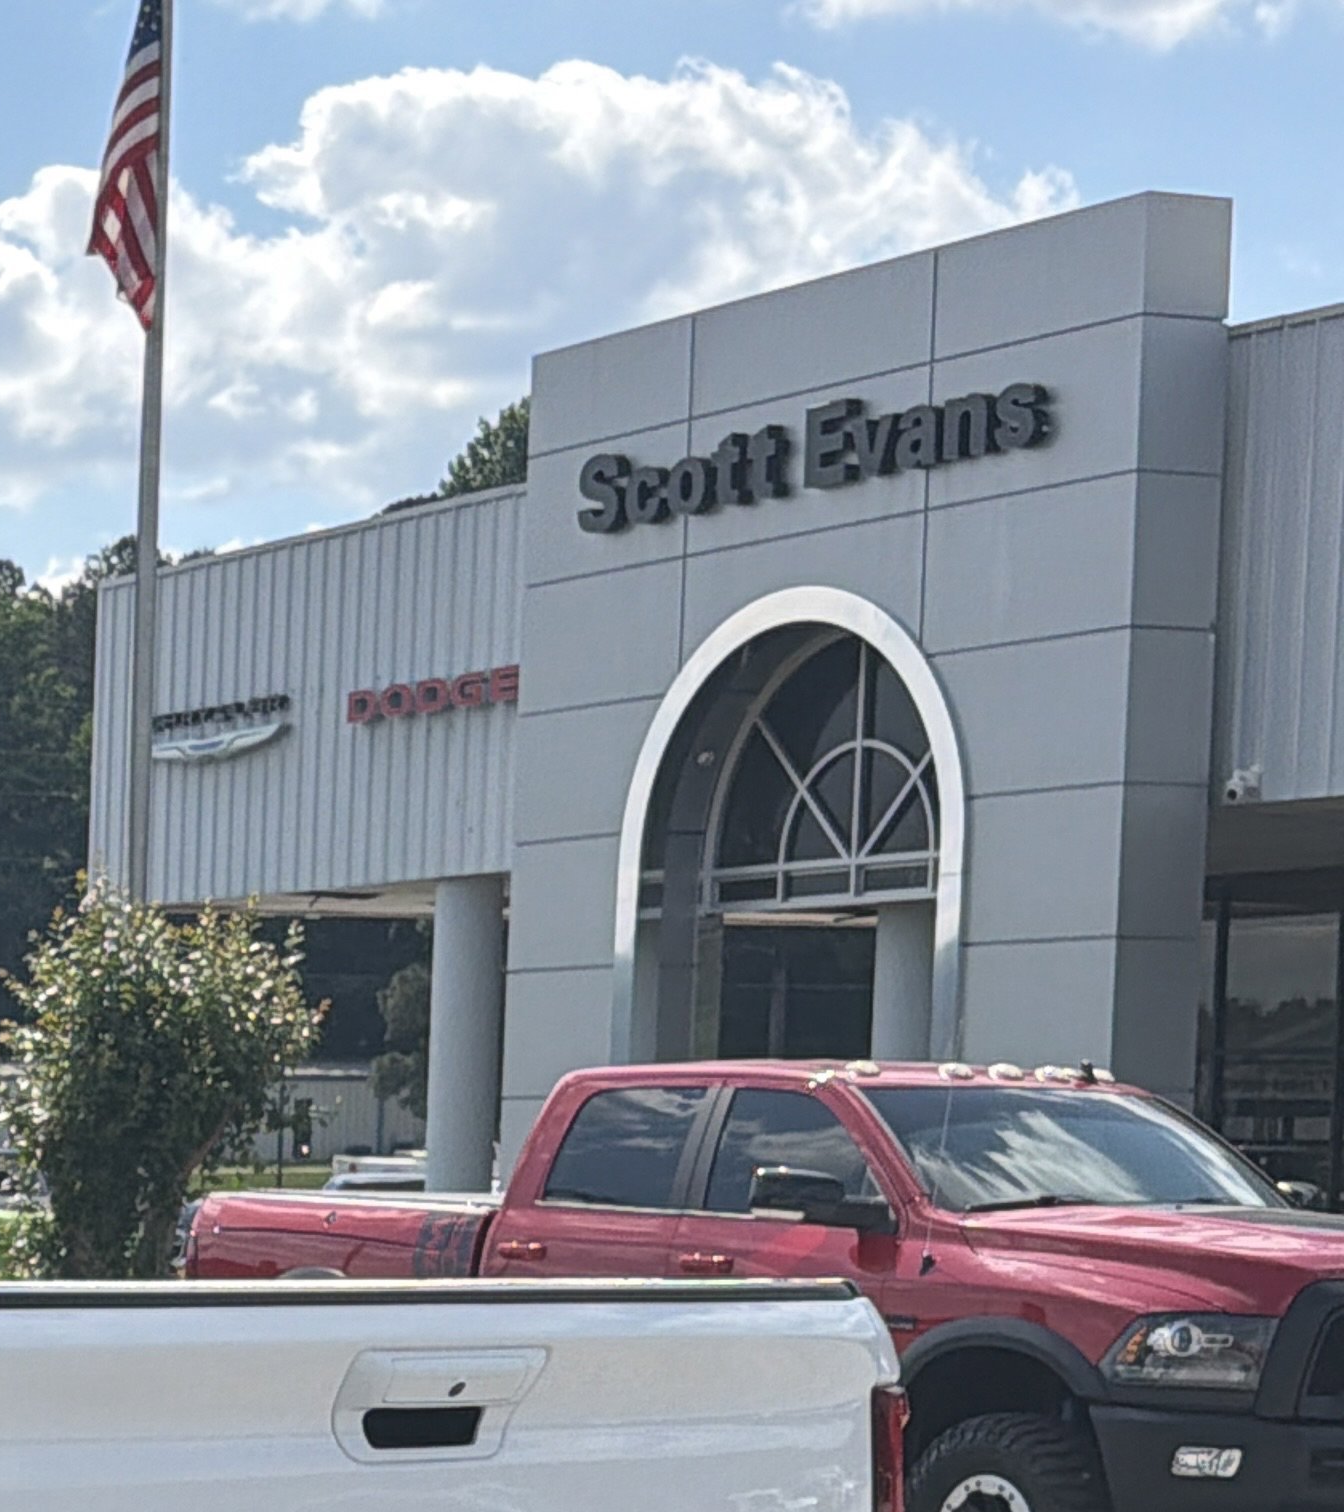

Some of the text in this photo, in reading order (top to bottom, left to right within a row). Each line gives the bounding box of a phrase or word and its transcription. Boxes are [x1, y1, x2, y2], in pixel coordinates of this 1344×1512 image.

[577, 382, 1060, 534] Scott Evans
[347, 664, 520, 724] DODGE
